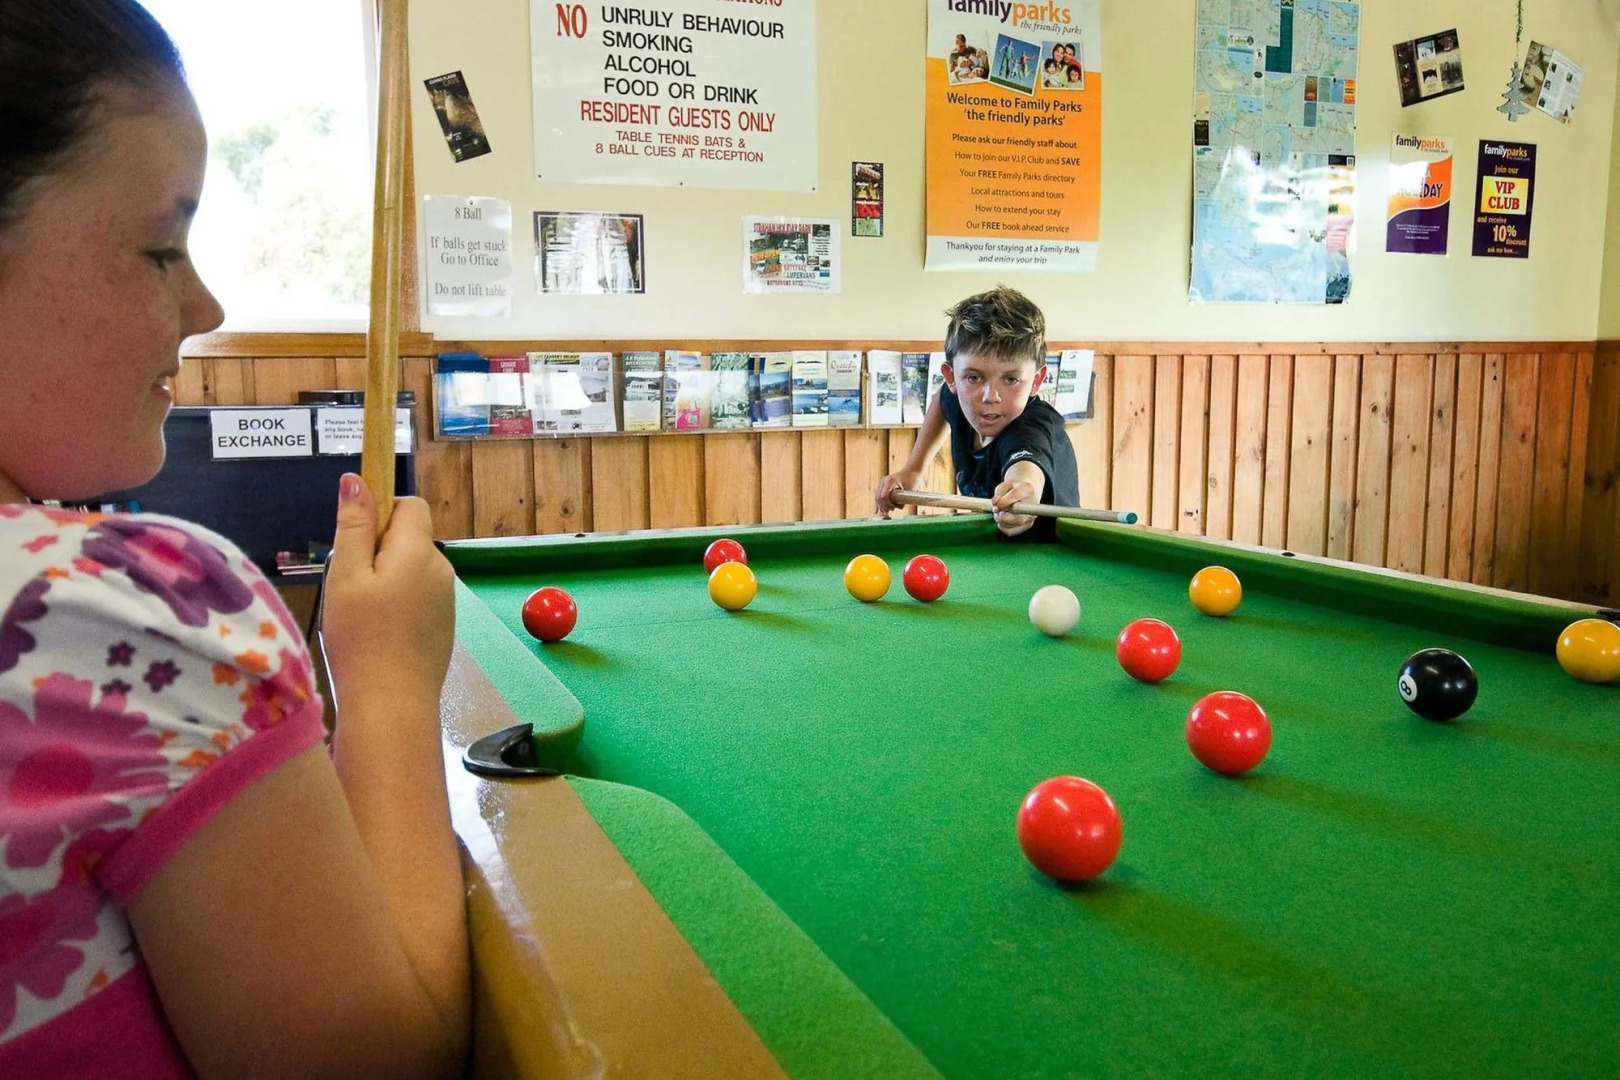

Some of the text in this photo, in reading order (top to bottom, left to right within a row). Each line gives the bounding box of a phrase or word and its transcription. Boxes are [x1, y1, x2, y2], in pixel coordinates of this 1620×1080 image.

[556, 3, 587, 39] NO
[602, 6, 784, 39] UNRULY BEHAVIOUR
[1020, 20, 1082, 35] the friendly parks
[603, 30, 693, 54] SMOKING
[604, 54, 696, 78] ALCOHOL
[604, 77, 759, 105] FOOD OR DRINK
[947, 92, 1082, 113] Welcome to Family Parks
[580, 100, 776, 133] RESIDENT GUESTS ONLY
[988, 111, 1030, 126] friendly
[616, 131, 746, 149] TABLE TENNIS BATS &
[952, 133, 977, 144] Please
[978, 135, 991, 144] ask
[1006, 136, 1036, 148] friendly
[1037, 139, 1054, 147] staff
[1054, 140, 1077, 149] about
[1396, 134, 1446, 150] familyparks
[595, 143, 764, 163] 8 BALL CUES AT RECEPTION
[1484, 144, 1528, 158] familyparks
[954, 152, 972, 160] How
[982, 153, 997, 163] join
[1027, 155, 1044, 164] Club
[1045, 157, 1060, 165] and
[1061, 157, 1081, 166] SAVE
[960, 169, 1075, 184] Your FREE Family Parks directory
[971, 187, 1064, 199] Local attractions and tours
[1495, 181, 1515, 194] VIP
[975, 204, 1061, 217] How to extend your stay
[1488, 196, 1520, 210] CLUB
[455, 207, 482, 220] 8 Ball
[966, 221, 1069, 233] Our FREE book ahead service
[1493, 225, 1517, 242] 10%
[430, 236, 508, 253] If balls get stuck
[946, 241, 984, 252] Thankyou
[985, 242, 996, 251] for
[997, 243, 1024, 253] staying
[1040, 245, 1064, 255] Family
[1064, 246, 1080, 254] Park
[440, 252, 499, 267] Go to Office
[978, 255, 993, 263] and
[994, 256, 1015, 264] enjoy
[1034, 257, 1047, 265] trip
[435, 283, 507, 297] Do not lift table
[238, 418, 285, 431] BOOK
[218, 435, 306, 447] EXCHANGE
[1400, 681, 1411, 695] 8
